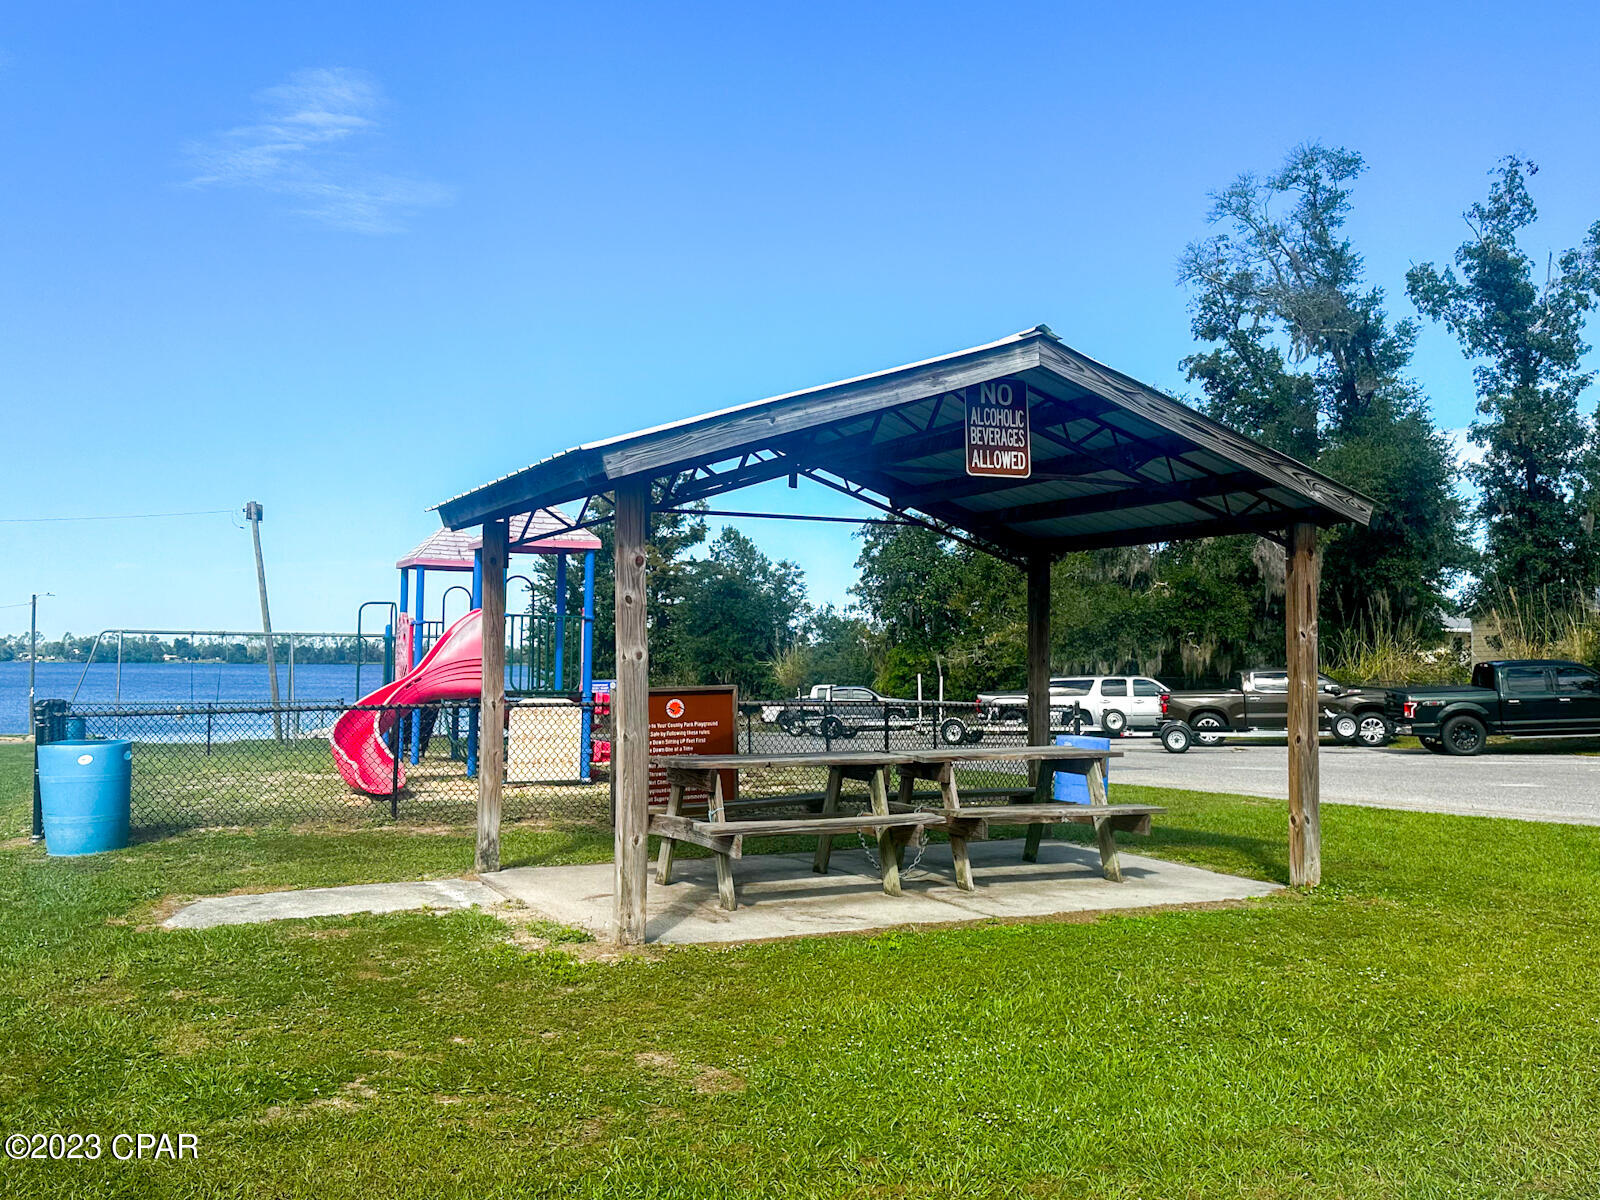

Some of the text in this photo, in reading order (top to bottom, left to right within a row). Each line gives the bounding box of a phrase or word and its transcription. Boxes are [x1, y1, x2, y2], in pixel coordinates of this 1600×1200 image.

[980, 383, 1012, 405] NO
[970, 407, 1025, 428] ALCOHOLIC
[970, 427, 1025, 447] BEVERAGES
[971, 449, 1026, 470] ALLOWED
